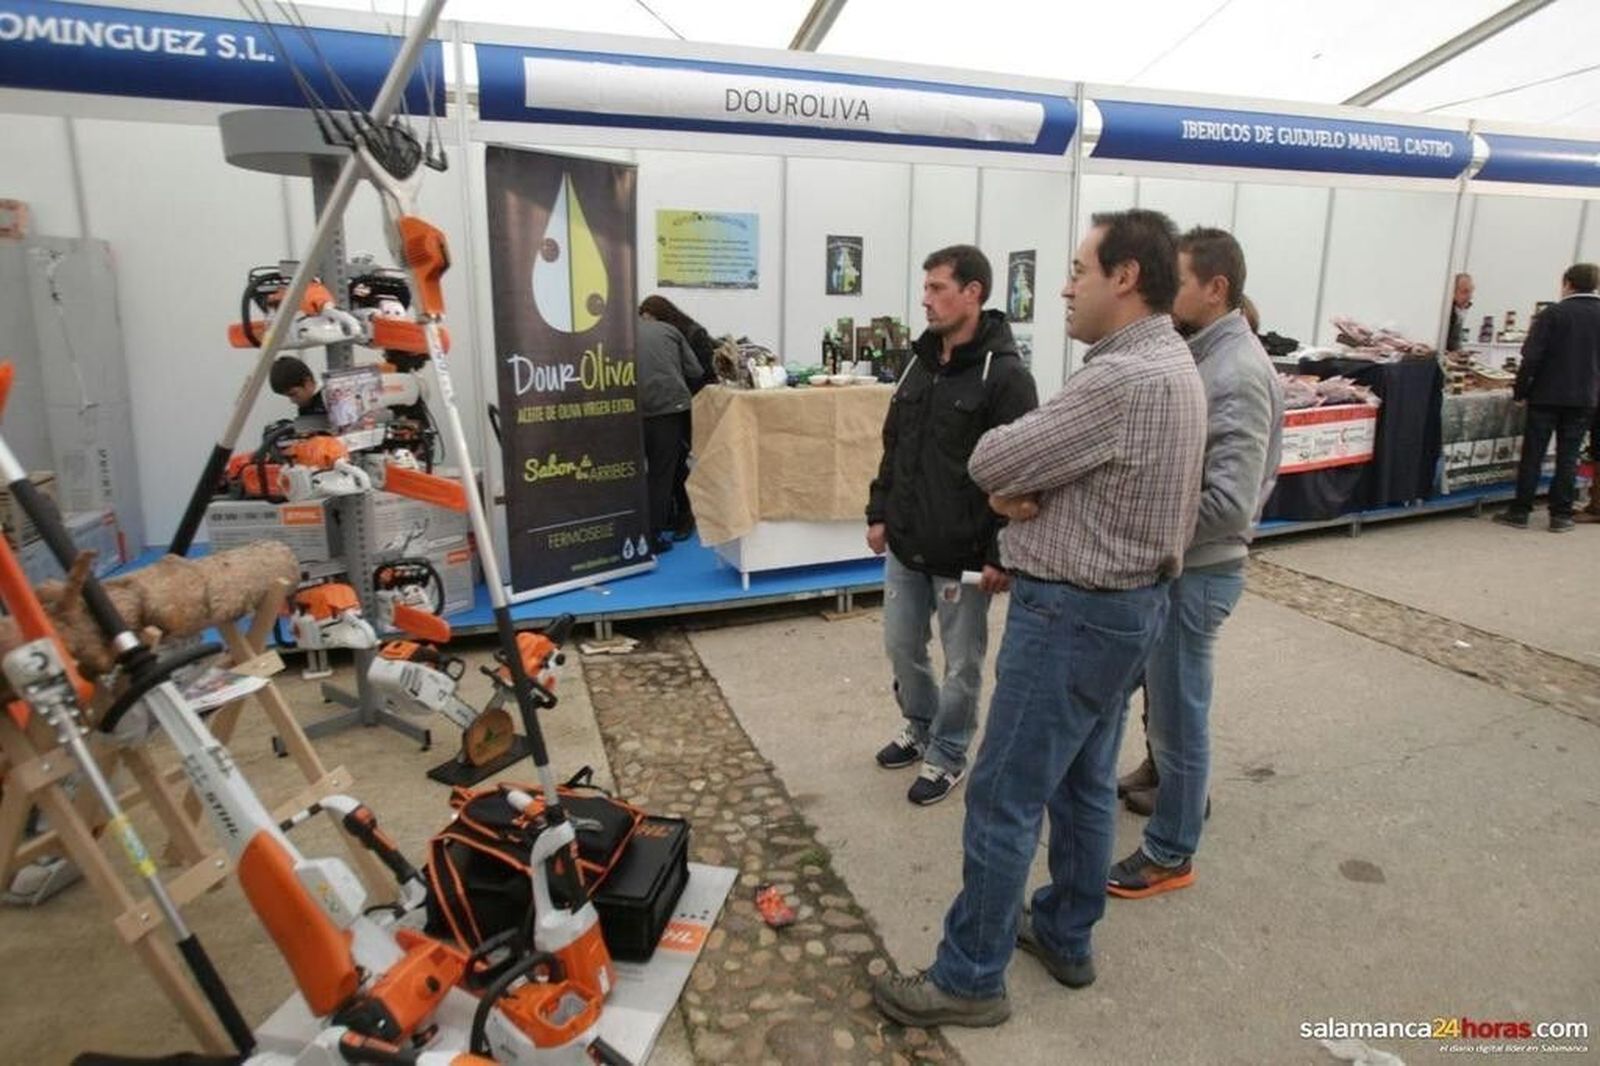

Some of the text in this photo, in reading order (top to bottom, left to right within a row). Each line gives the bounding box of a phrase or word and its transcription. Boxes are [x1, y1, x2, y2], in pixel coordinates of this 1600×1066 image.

[217, 35, 275, 63] S.L.
[725, 89, 870, 122] DOUROLIVA
[1181, 120, 1453, 158] IBERICOS DE GUIJUELO MANUEL CASTRO
[523, 453, 576, 482] Sabor
